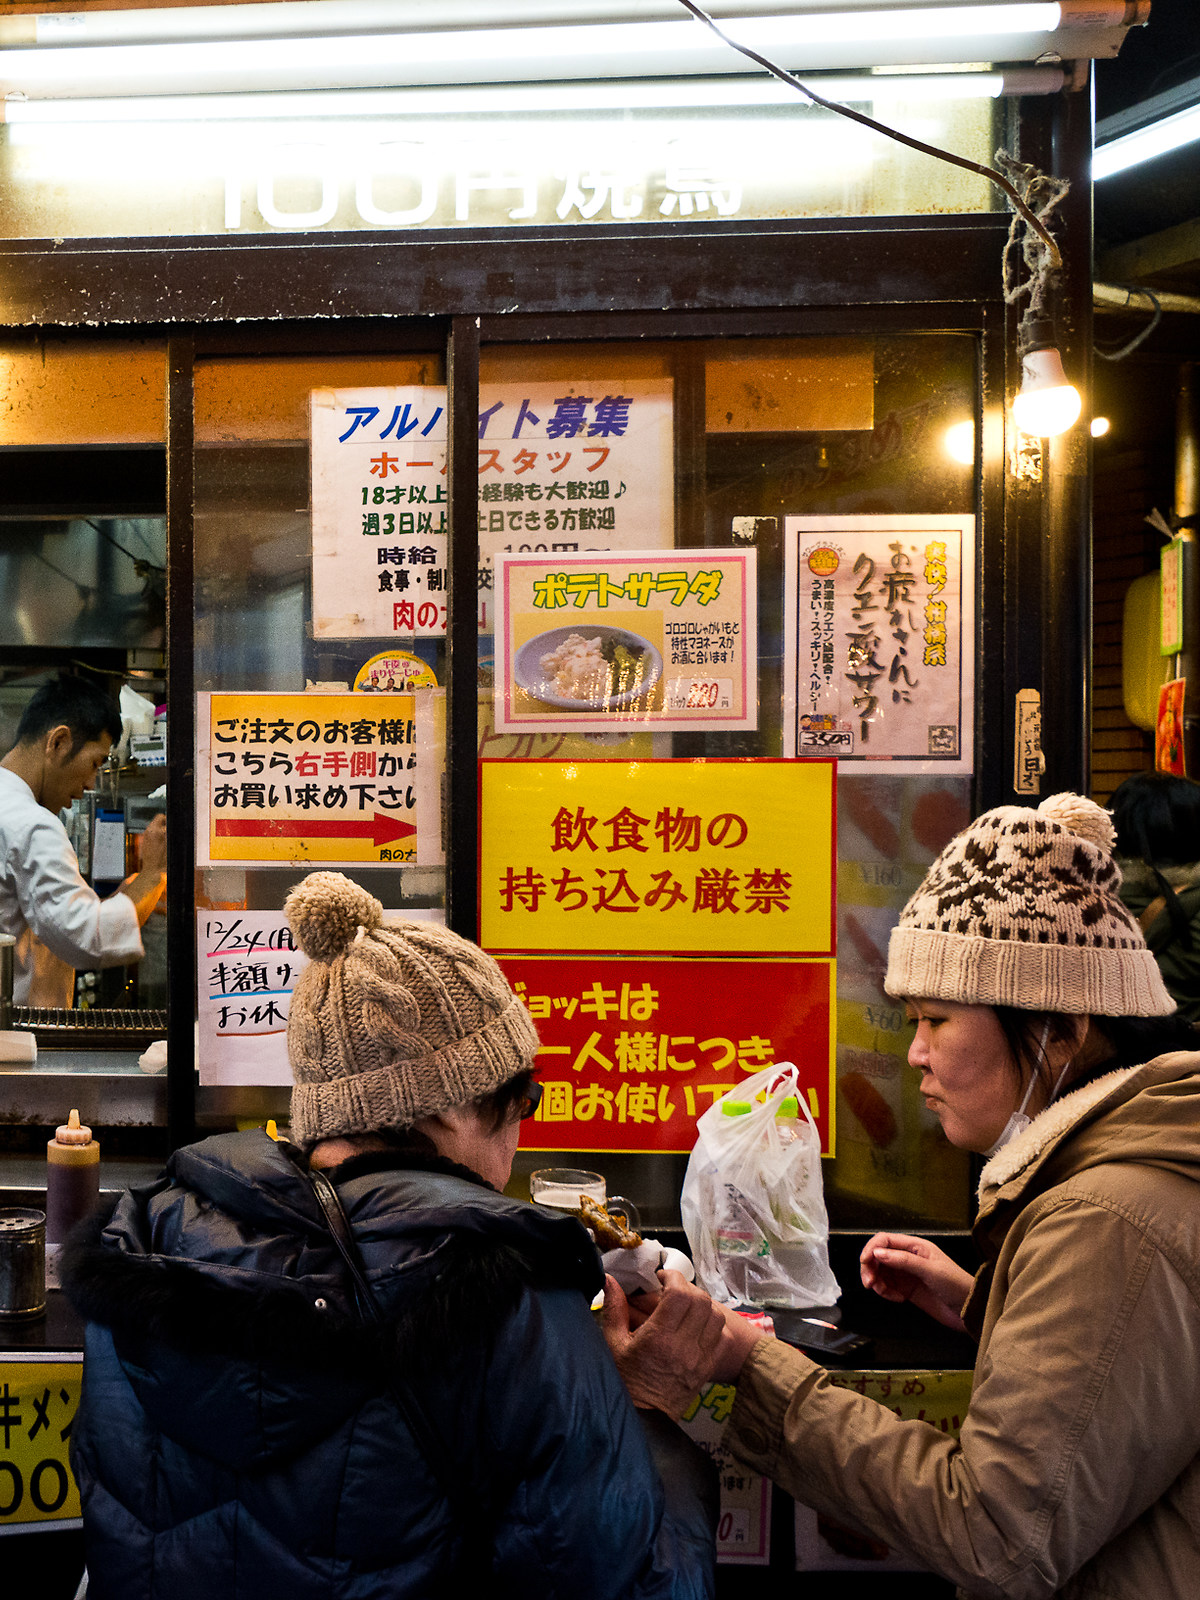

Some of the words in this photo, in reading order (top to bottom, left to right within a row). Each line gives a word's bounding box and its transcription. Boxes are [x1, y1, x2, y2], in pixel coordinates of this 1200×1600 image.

[369, 447, 611, 479] ホースタッフ
[377, 545, 437, 565] 時給
[533, 570, 723, 609] ポテトサラダ
[393, 599, 486, 631] 肉の
[665, 622, 739, 634] ゴロゴロじゃがいもと
[879, 540, 919, 704] お疲れさんに
[845, 552, 885, 742] クエン酸サワー
[550, 806, 748, 853] 飲食物の
[500, 867, 792, 914] 持ち込み厳禁
[208, 963, 299, 993] 半額サ
